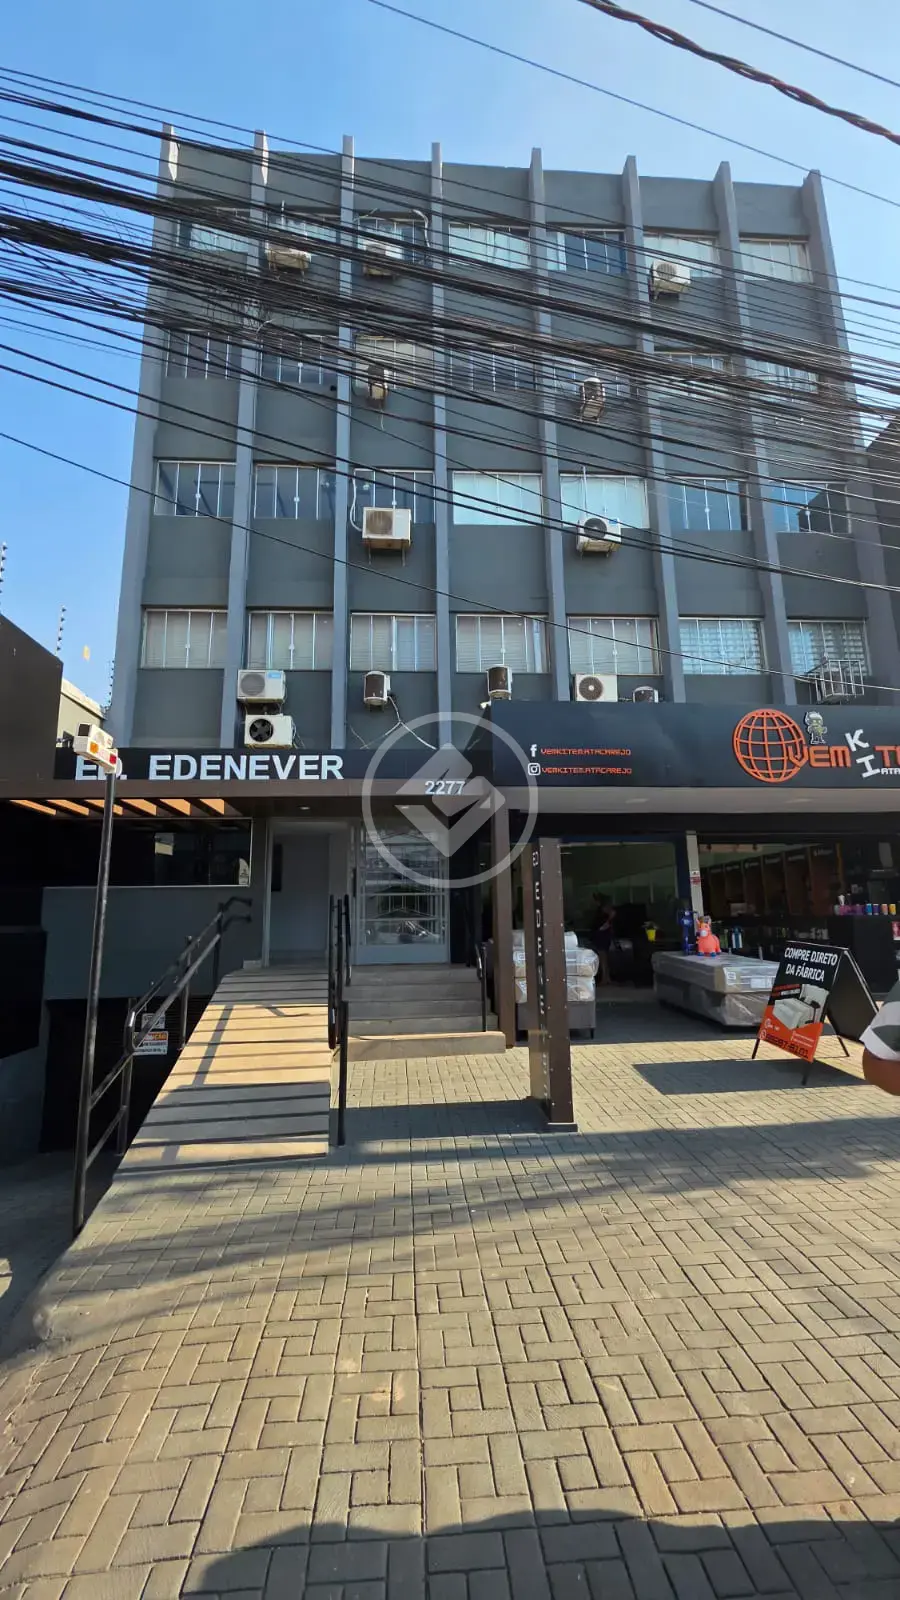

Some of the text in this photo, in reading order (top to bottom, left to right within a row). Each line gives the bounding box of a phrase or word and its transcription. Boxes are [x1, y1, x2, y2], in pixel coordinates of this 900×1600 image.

[787, 743, 851, 768] VEM
[149, 754, 344, 781] EDENEVER
[424, 780, 466, 796] 2277
[784, 947, 838, 966] COMPRE DIRETO
[785, 962, 826, 982] DA FÁBRICA
